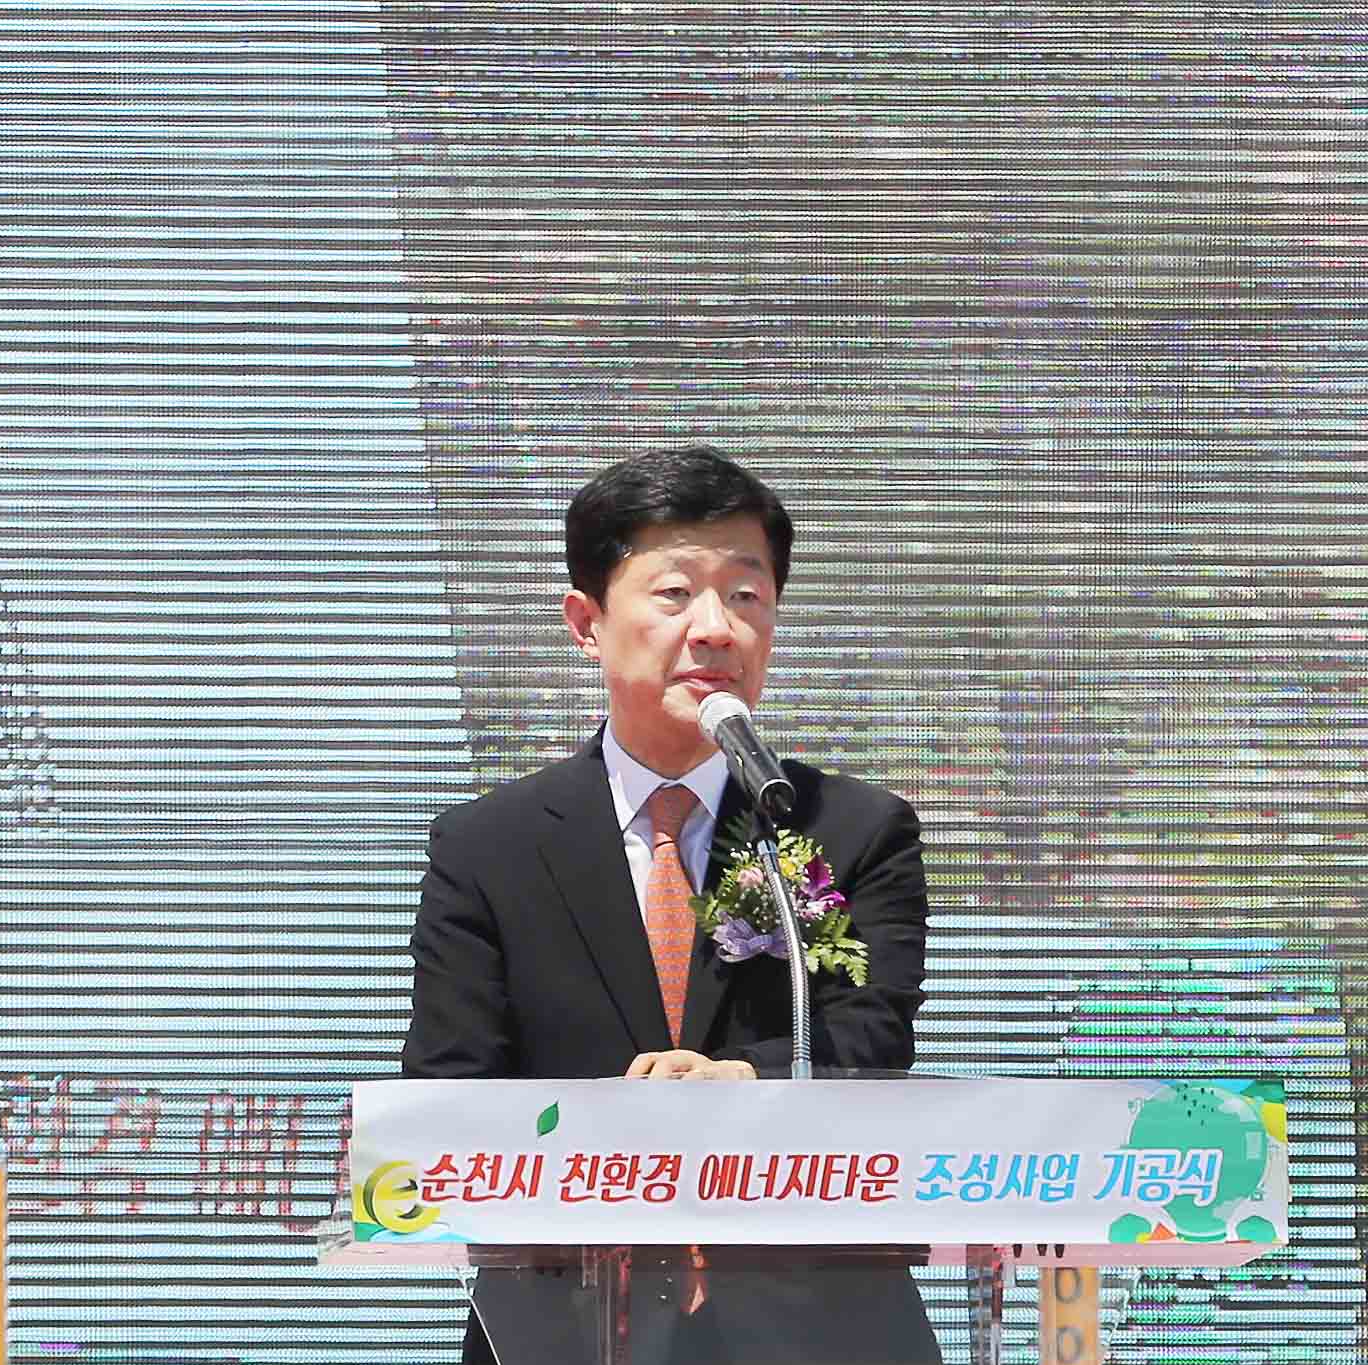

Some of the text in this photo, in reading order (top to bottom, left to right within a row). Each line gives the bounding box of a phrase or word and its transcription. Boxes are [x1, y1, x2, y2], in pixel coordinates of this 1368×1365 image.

[422, 1152, 1219, 1204] 순천시 친환경 에너지타운 조성사업 기공식
